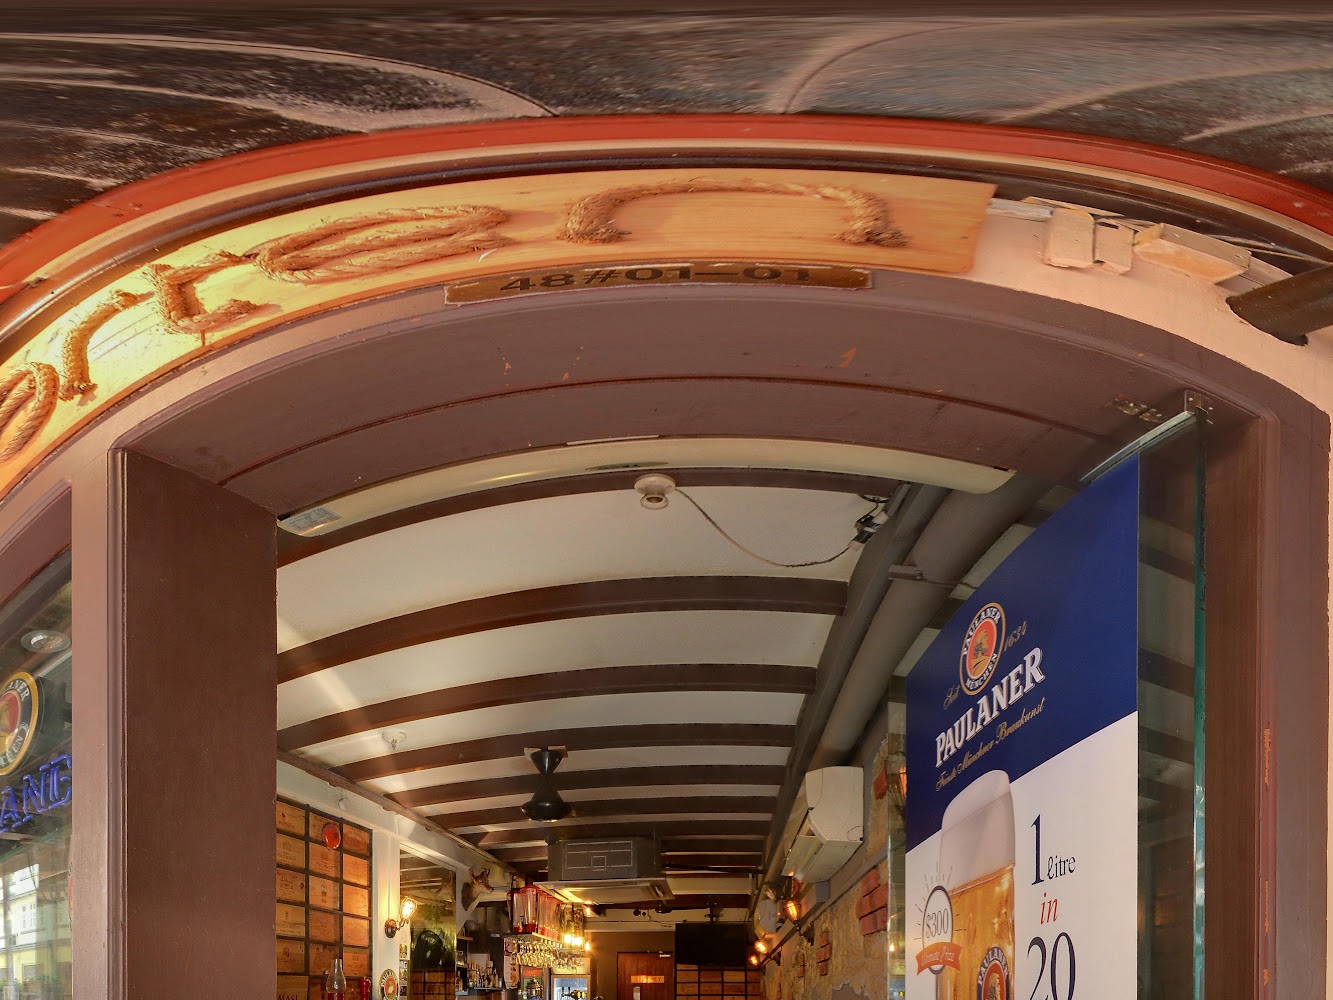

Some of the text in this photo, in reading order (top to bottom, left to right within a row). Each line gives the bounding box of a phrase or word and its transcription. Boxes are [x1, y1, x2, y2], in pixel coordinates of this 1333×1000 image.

[963, 607, 1001, 655] PAULANER
[1004, 621, 1027, 651] 1634
[966, 652, 998, 690] MÜNCHEN
[935, 647, 1046, 768] PAULANER
[1031, 814, 1076, 885] 1 litre
[925, 908, 949, 938] $300
[1040, 892, 1058, 924] in
